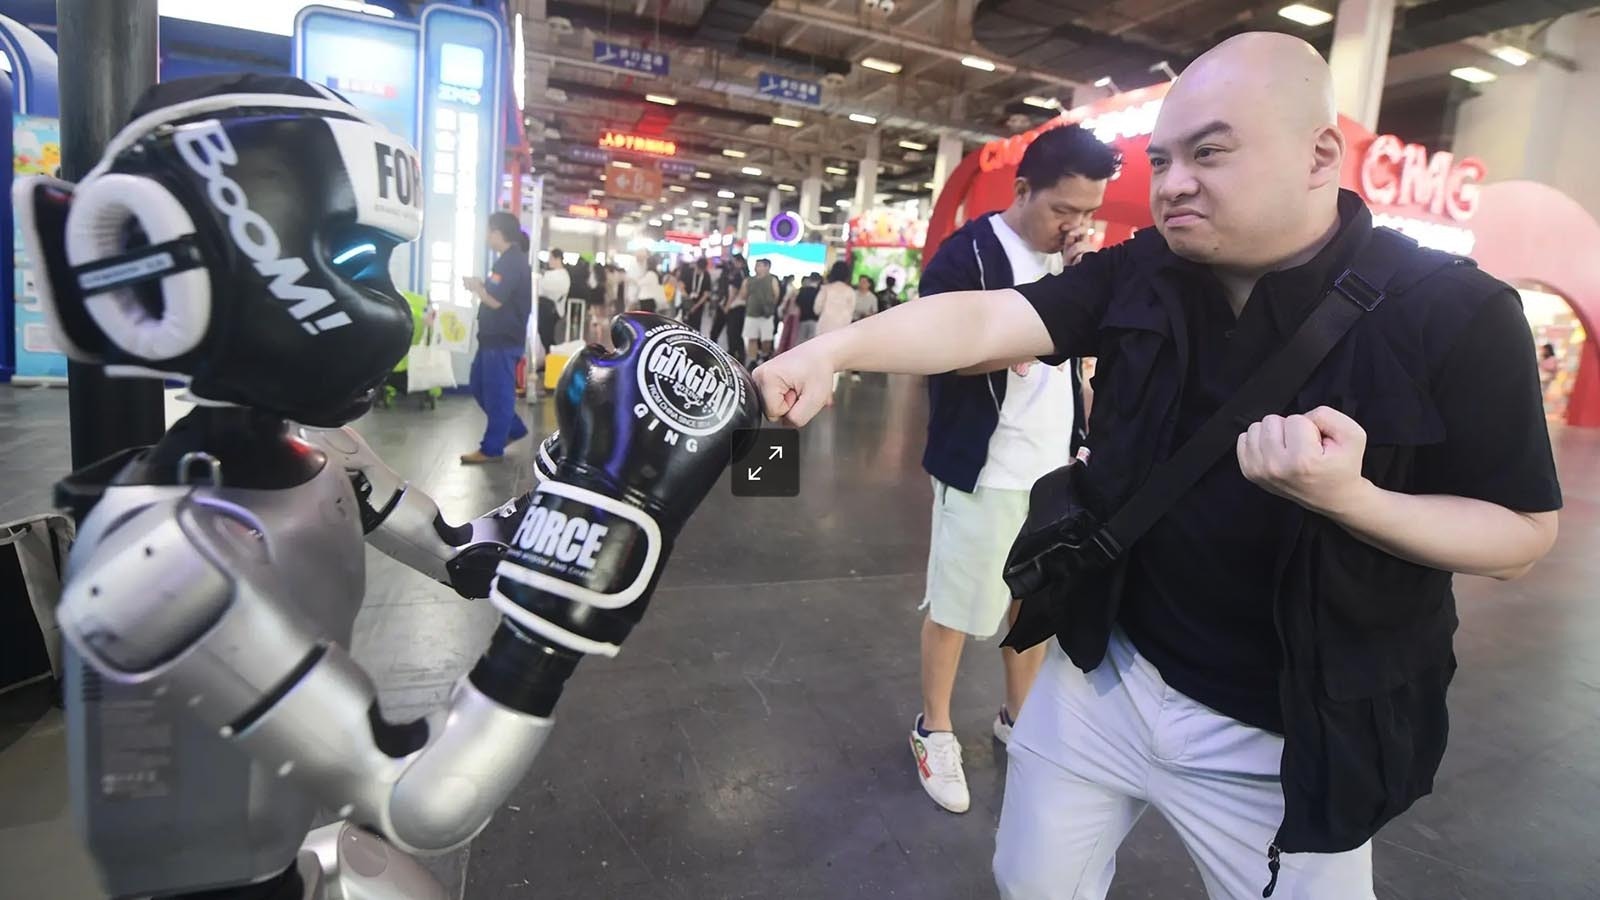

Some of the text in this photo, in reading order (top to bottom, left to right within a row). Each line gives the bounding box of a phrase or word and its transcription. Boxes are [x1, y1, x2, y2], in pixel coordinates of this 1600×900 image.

[1361, 133, 1488, 221] CMG
[174, 119, 352, 336] BOOM!
[647, 342, 735, 421] GINGPAI
[510, 504, 609, 570] FORCE
